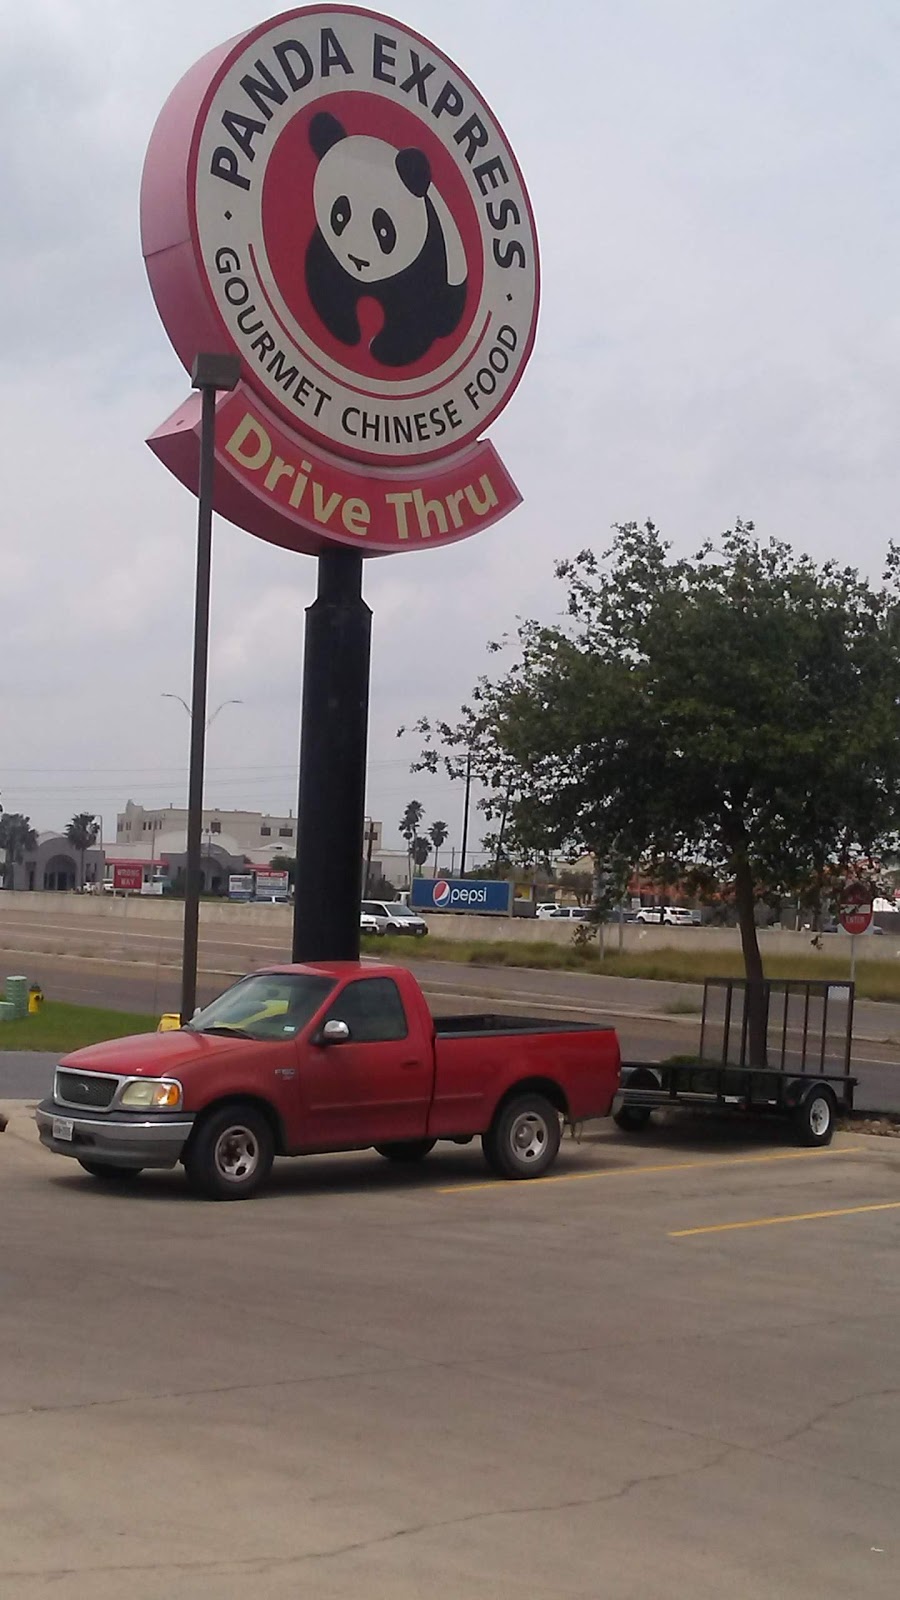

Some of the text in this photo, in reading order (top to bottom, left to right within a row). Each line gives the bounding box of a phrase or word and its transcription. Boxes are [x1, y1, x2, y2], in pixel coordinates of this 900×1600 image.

[210, 27, 526, 269] PANDA EXPRESS
[215, 247, 518, 444] GOURMET CHINESE FOOD
[224, 412, 499, 540] Drive Thru
[450, 886, 487, 904] pepsi
